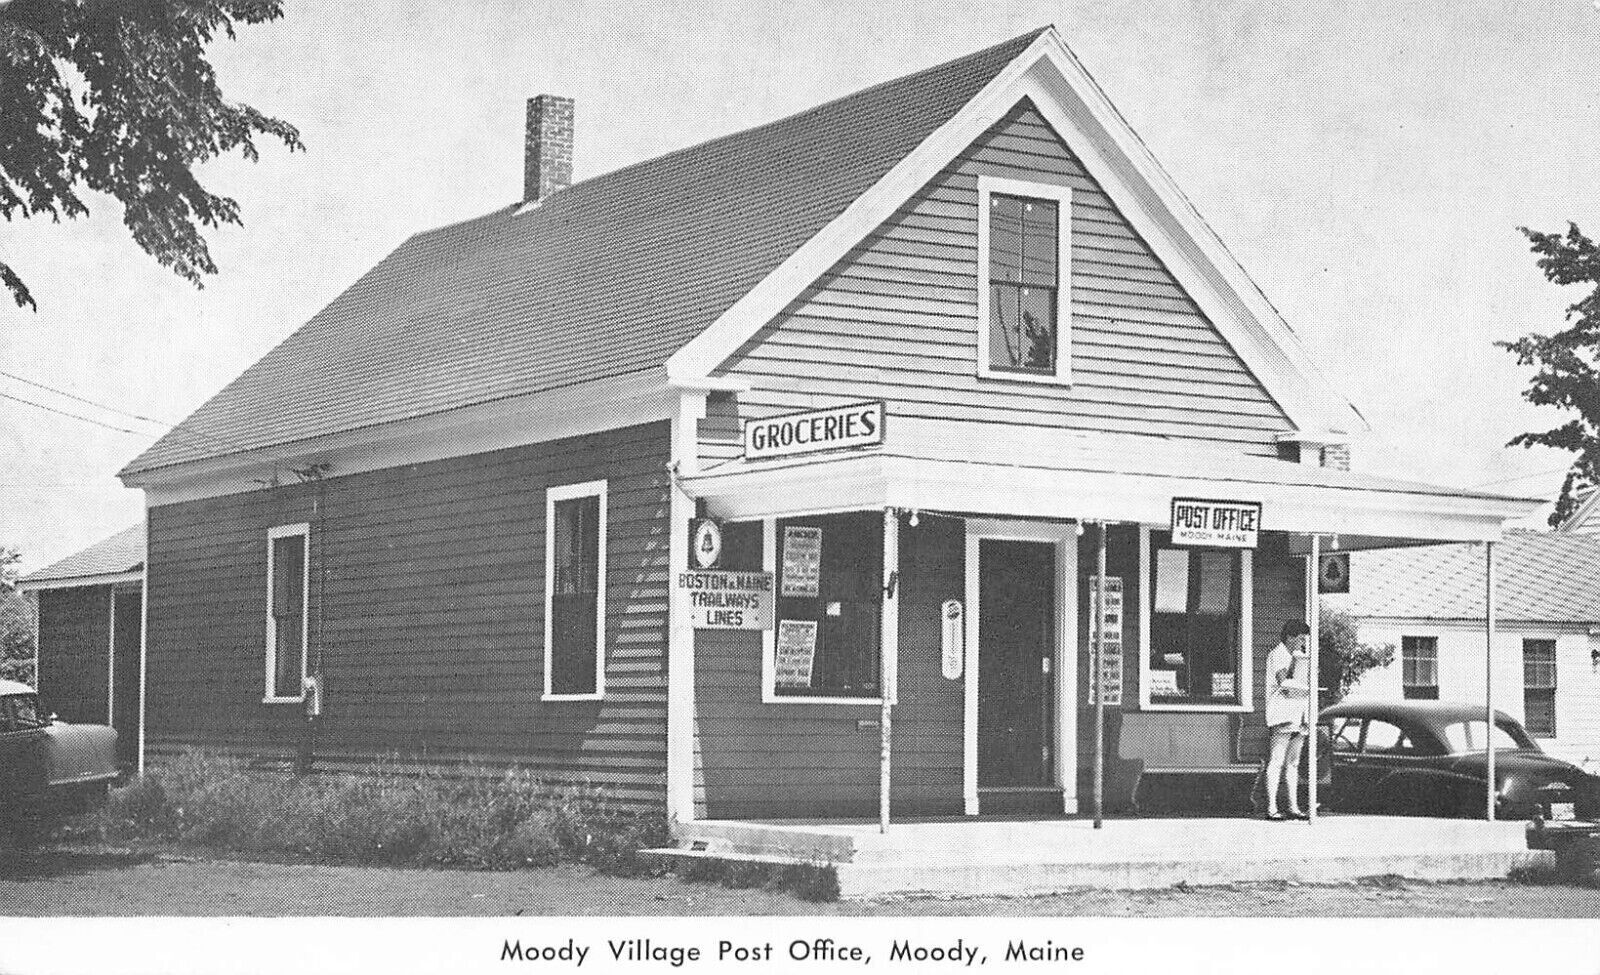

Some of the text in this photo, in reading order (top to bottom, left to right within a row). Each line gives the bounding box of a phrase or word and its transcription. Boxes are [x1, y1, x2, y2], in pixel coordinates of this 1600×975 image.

[752, 410, 875, 450] GROCERIES
[1176, 505, 1256, 531] POST OFFICE
[1180, 531, 1247, 542] MOODY MAINE
[679, 573, 728, 590] BOSTON
[736, 575, 772, 592] MAINE
[690, 591, 760, 609] TRAILWAYS
[706, 610, 743, 626] LINES
